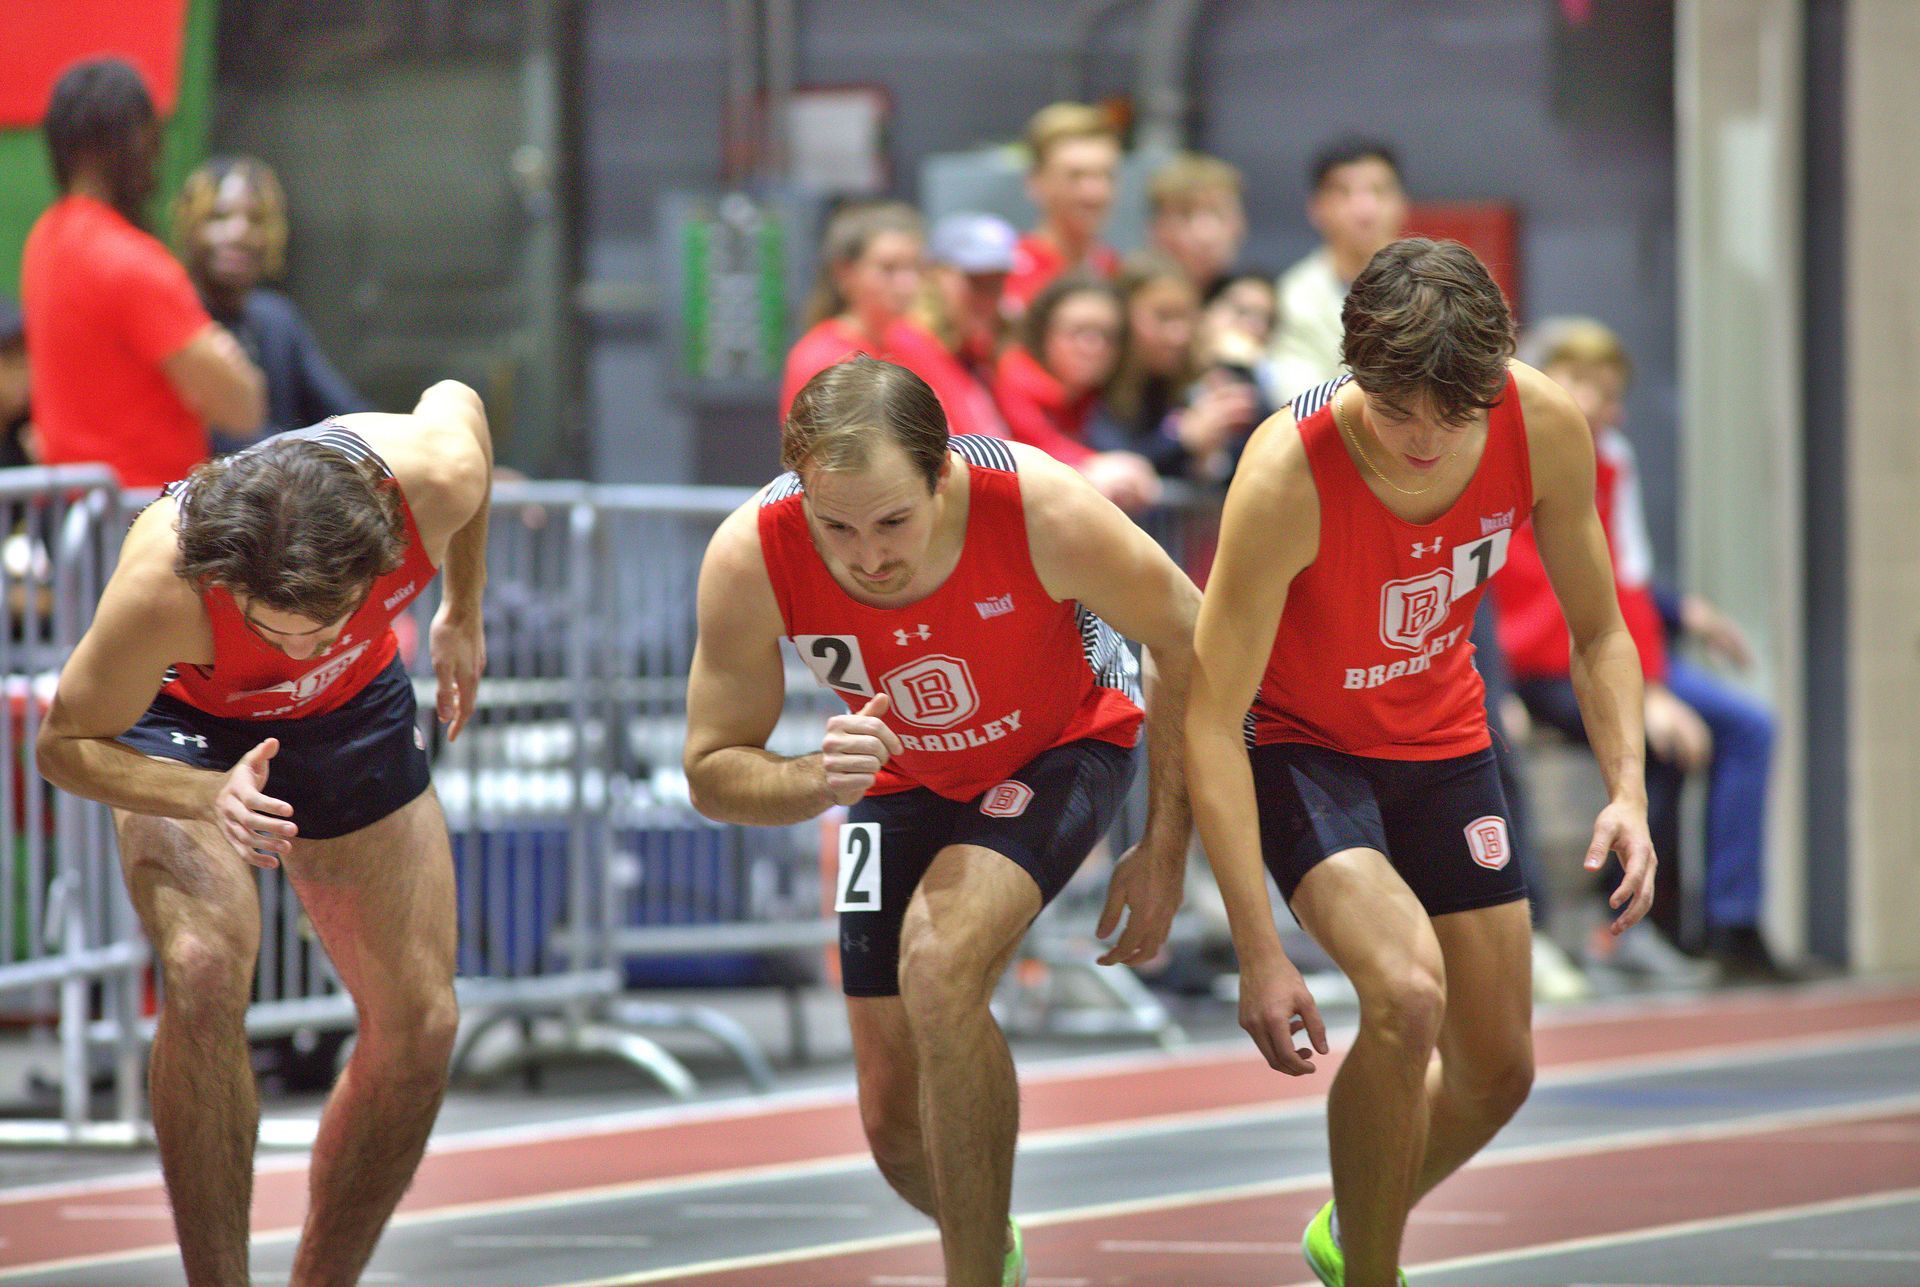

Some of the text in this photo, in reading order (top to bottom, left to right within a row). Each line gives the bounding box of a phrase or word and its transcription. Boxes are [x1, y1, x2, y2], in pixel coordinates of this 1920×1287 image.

[1469, 539, 1493, 588] 1
[811, 637, 863, 692] 2
[902, 668, 959, 719] B
[898, 709, 1022, 752] RADLEY
[989, 786, 1018, 810] B
[845, 826, 871, 904] 2
[1477, 826, 1503, 859] B
